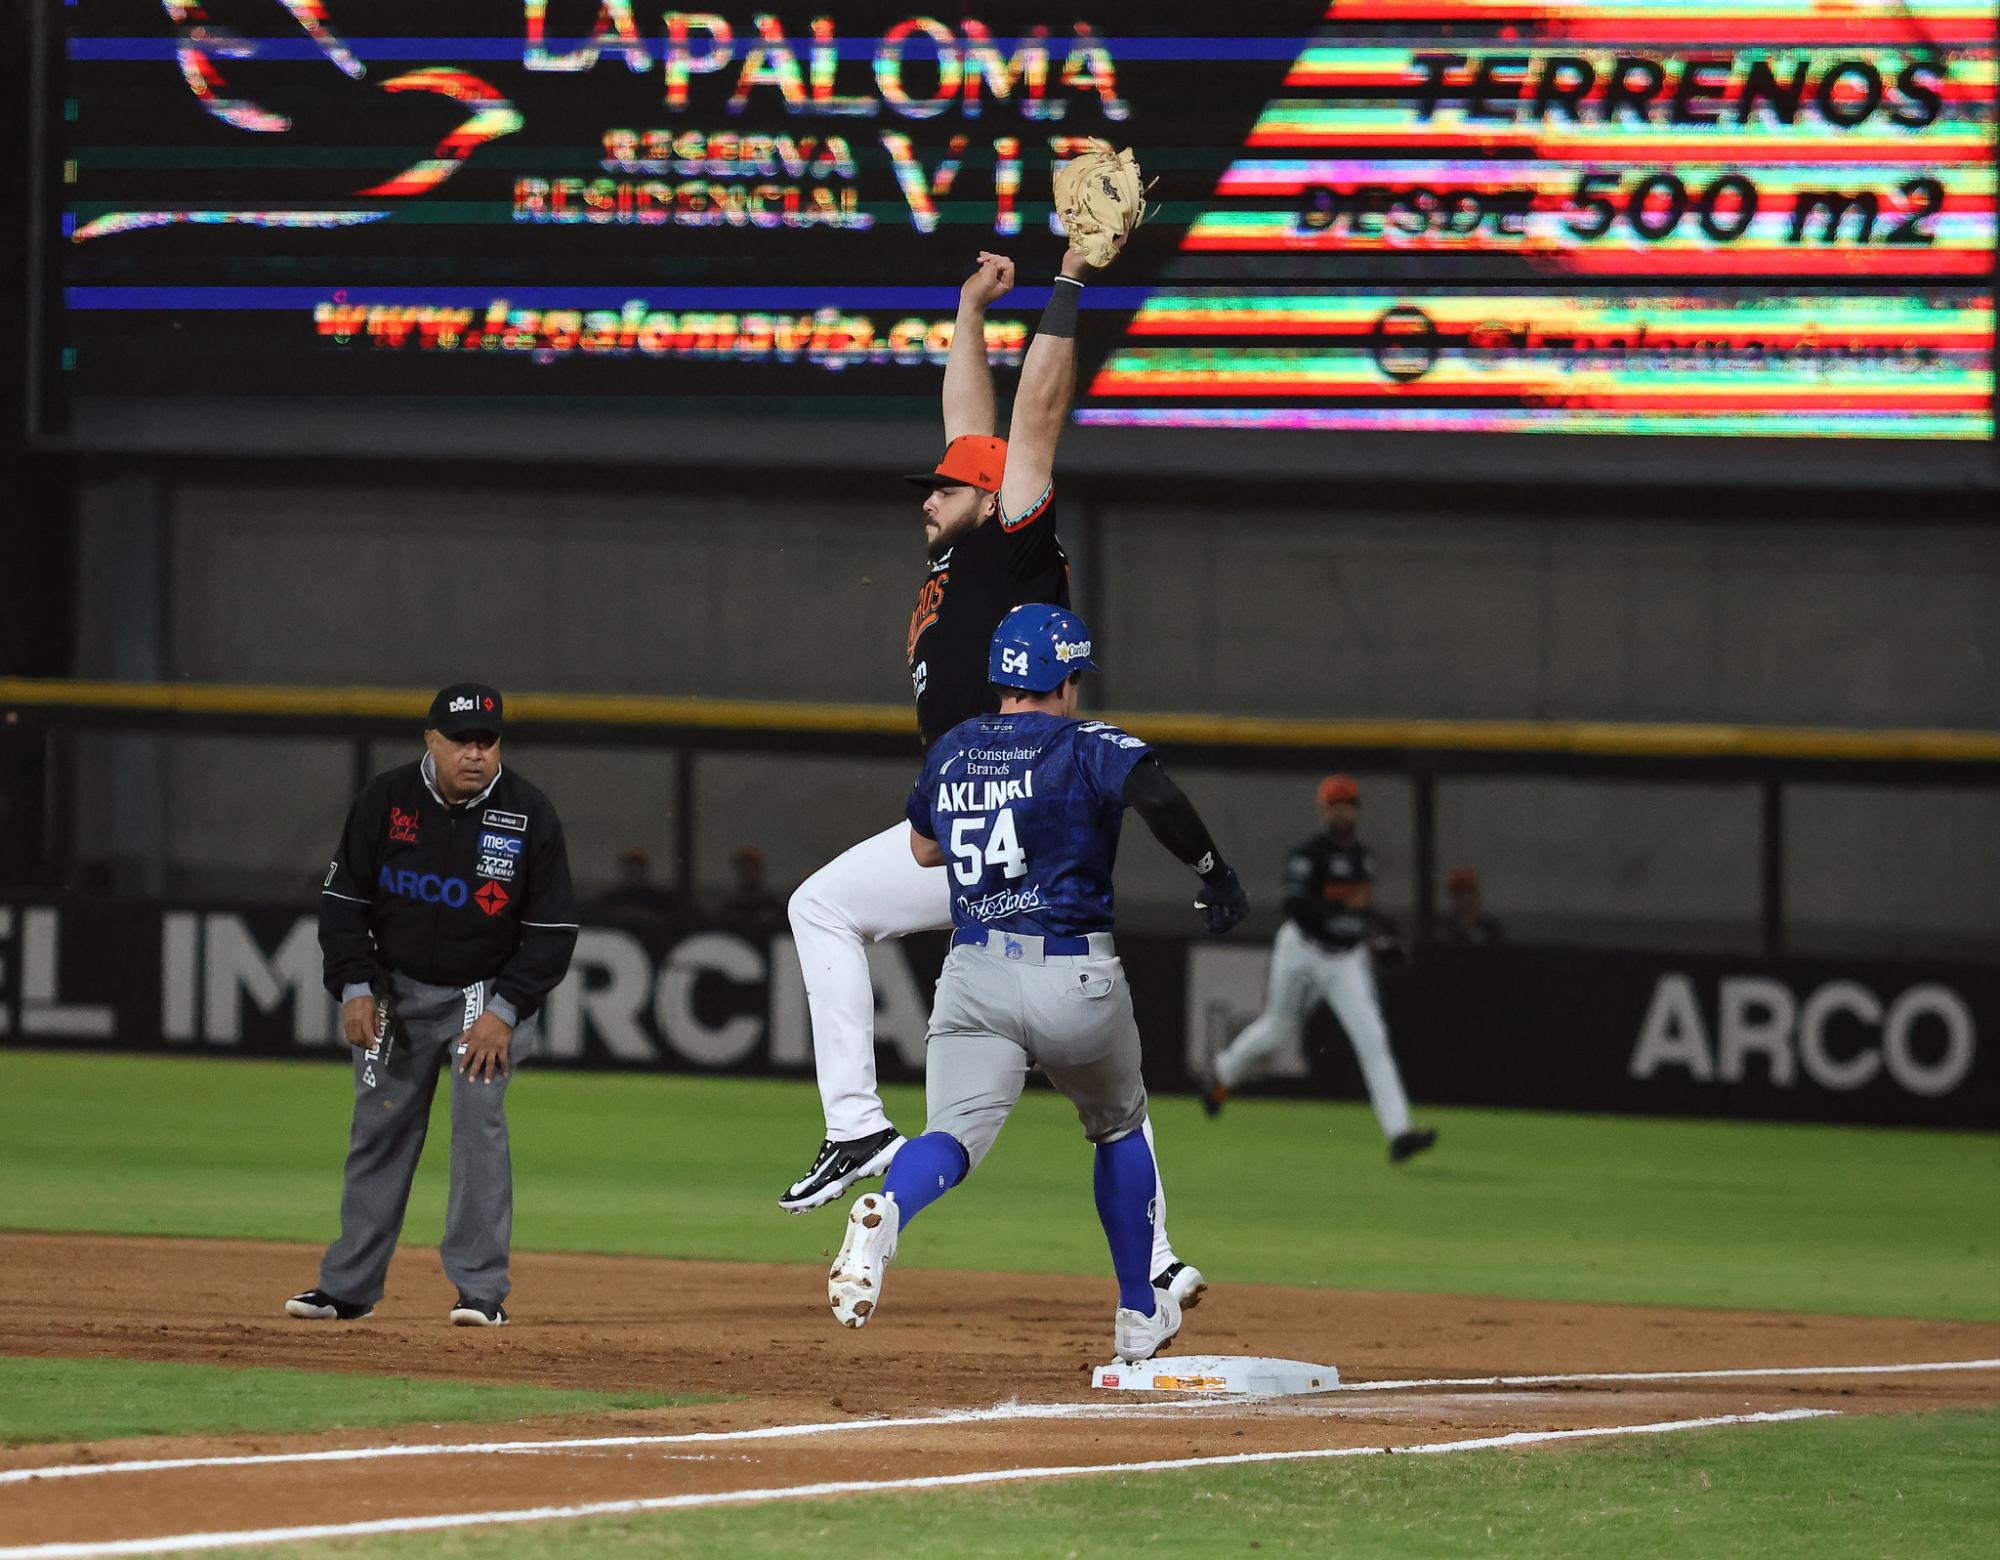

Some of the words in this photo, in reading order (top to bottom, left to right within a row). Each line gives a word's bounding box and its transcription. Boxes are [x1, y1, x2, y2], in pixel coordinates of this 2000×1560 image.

[523, 0, 654, 73] LA
[662, 11, 1131, 121] PALOMA
[1410, 51, 1949, 128] TERRENOS
[601, 129, 856, 179] RESERVA
[512, 177, 875, 229] RESIDENCIAL
[1296, 184, 1537, 237] DESDE
[1565, 171, 1758, 243] 500
[1788, 176, 1946, 245] m2
[1002, 647, 1028, 676] 54
[966, 763, 1010, 776] Brands
[951, 808, 1028, 886] 54
[378, 864, 468, 909] ARCO
[0, 905, 113, 1038] L
[1630, 974, 1977, 1097] ARCO
